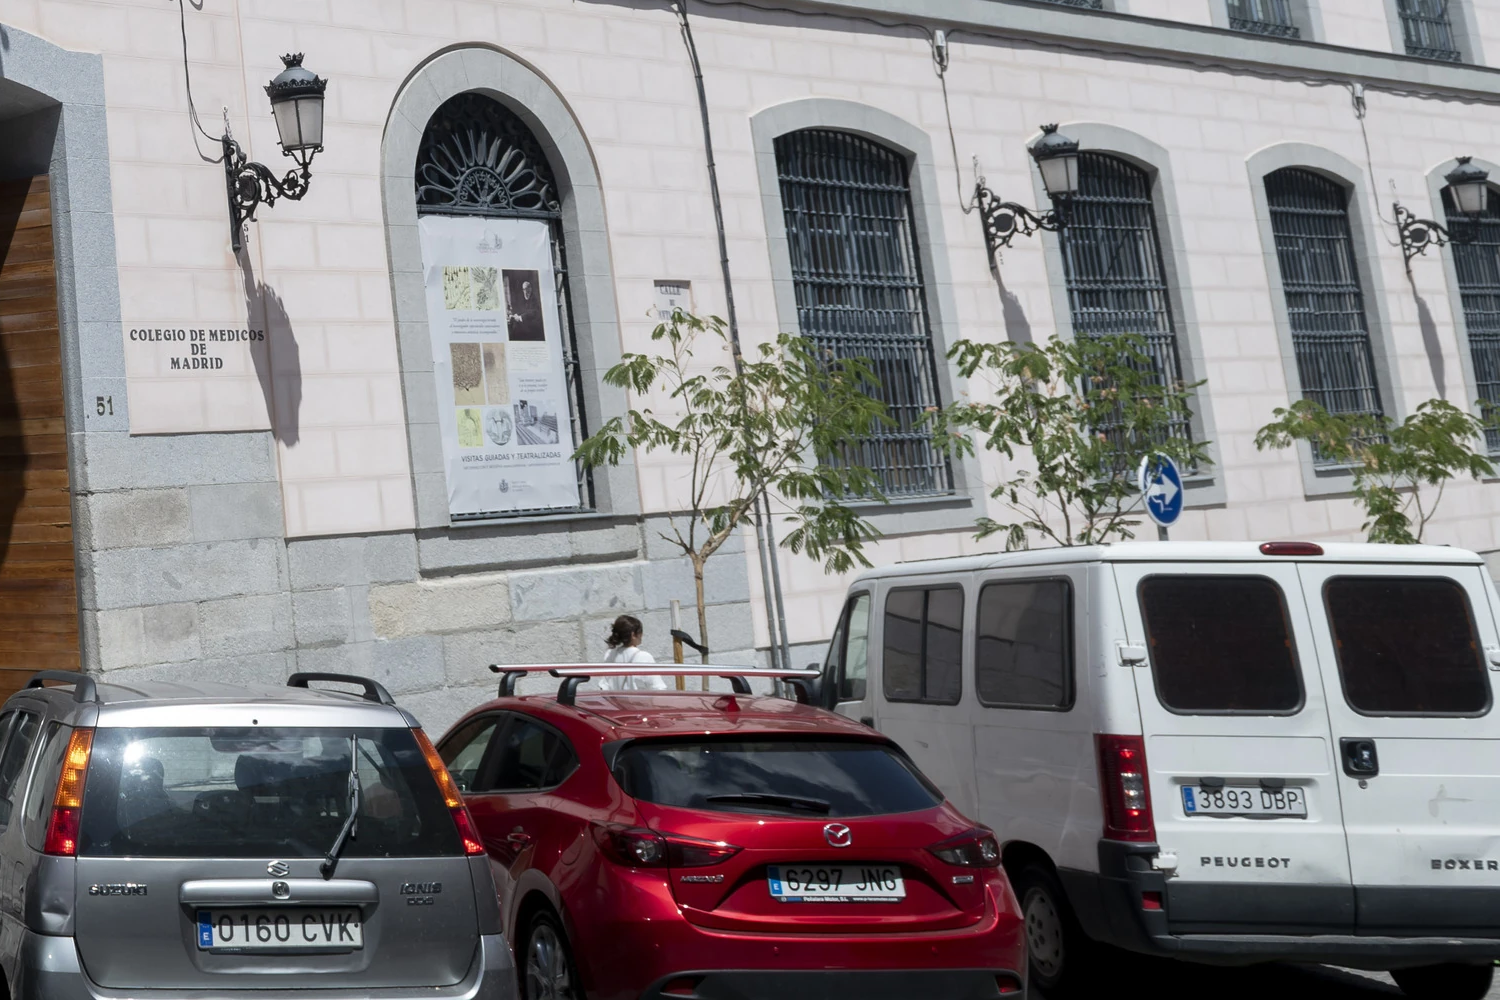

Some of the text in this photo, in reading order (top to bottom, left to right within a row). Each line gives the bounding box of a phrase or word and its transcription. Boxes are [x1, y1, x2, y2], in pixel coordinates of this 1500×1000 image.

[660, 285, 681, 295] CALLE
[130, 329, 264, 342] COLEGIO DE MEDICOS
[191, 343, 207, 356] DE
[170, 357, 223, 370] MADRID
[96, 396, 114, 415] 51
[485, 453, 510, 461] GUIADAS
[517, 451, 561, 460] TEATRALIZADAS
[1198, 790, 1298, 810] 3893 DBP
[1200, 856, 1291, 868] PEUGEOT
[1431, 859, 1498, 870] BOXER
[786, 868, 897, 891] 6297 JNG
[88, 883, 148, 896] SUZUKI
[400, 882, 442, 895] IGNIS
[773, 883, 780, 891] E
[218, 914, 355, 942] 0160 CVK
[203, 932, 210, 941] E
